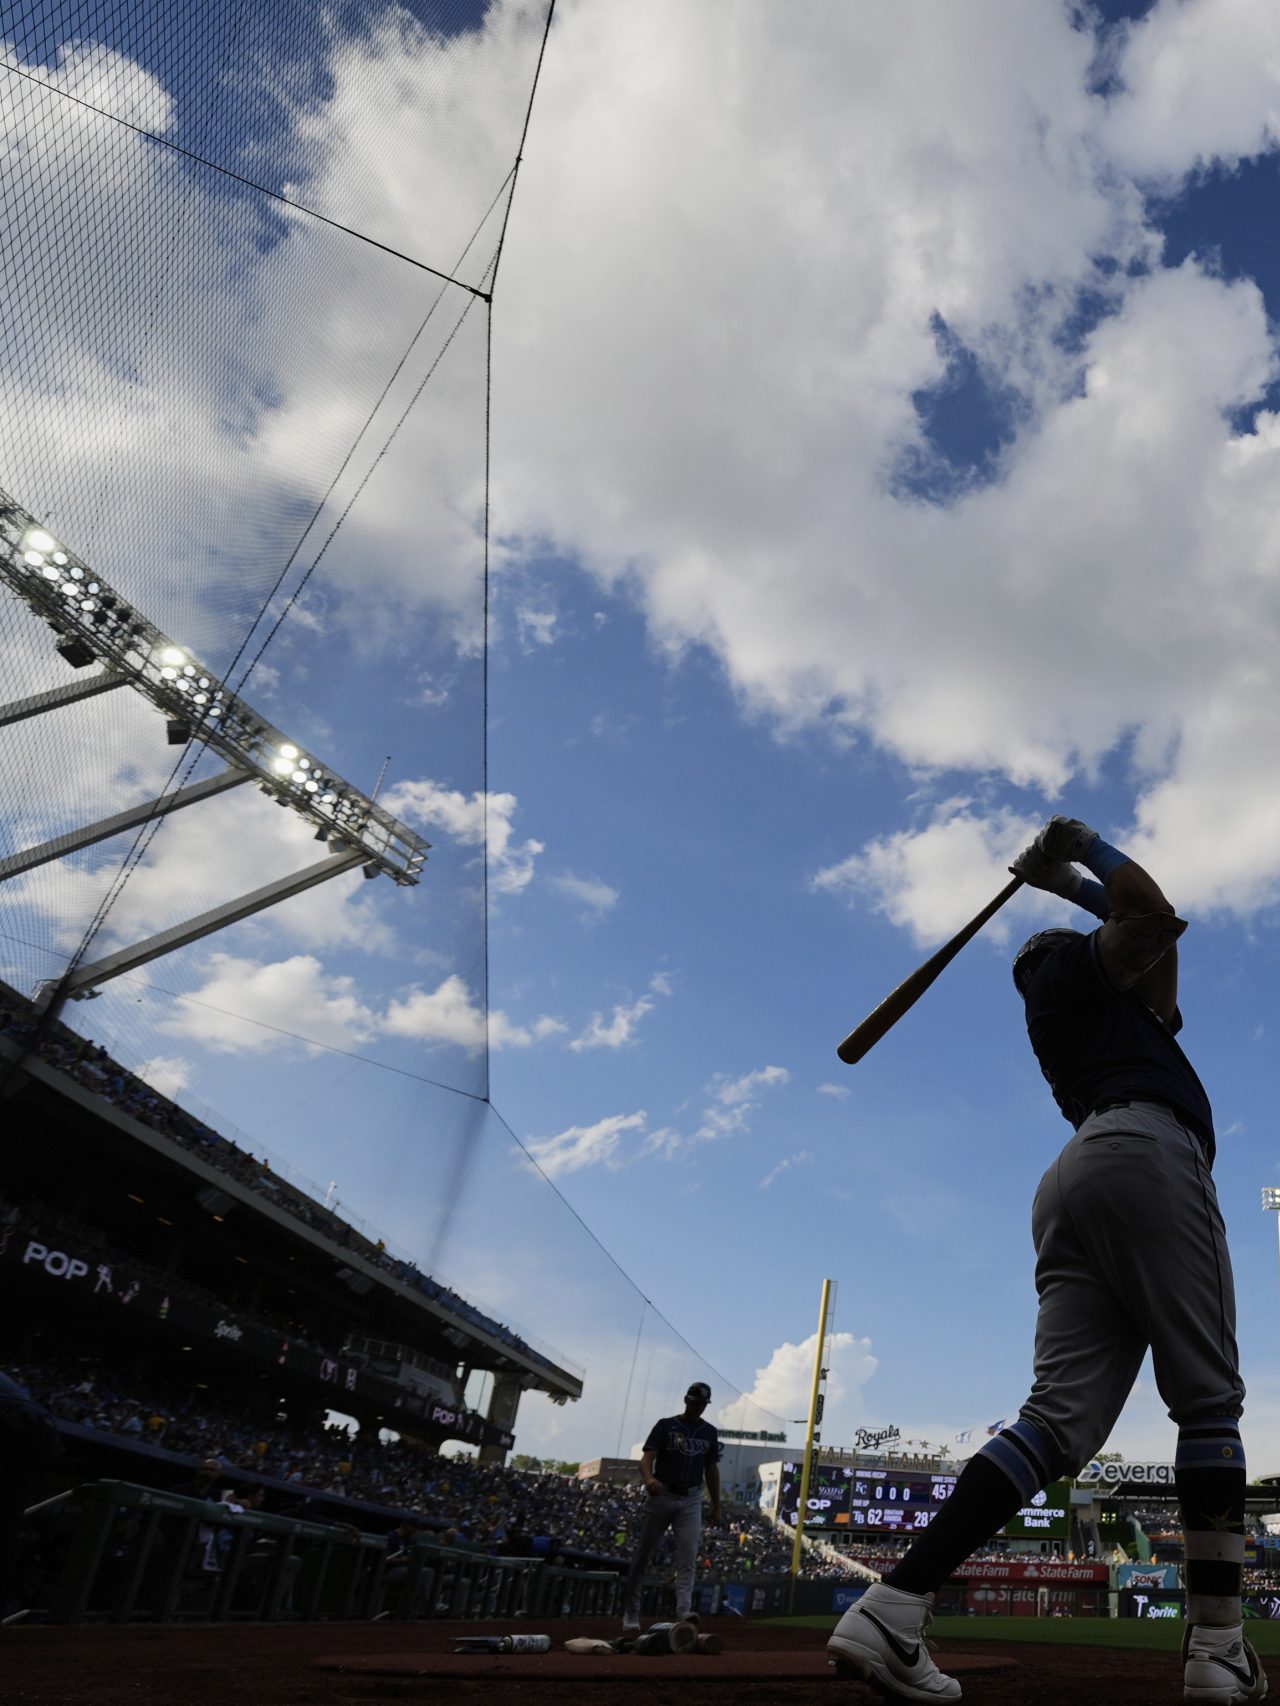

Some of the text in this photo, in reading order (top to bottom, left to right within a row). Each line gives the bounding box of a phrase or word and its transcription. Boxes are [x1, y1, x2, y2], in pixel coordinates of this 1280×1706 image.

[23, 1240, 89, 1280] POP
[432, 1406, 456, 1426] POP
[717, 1430, 787, 1442] mmerce Bank
[855, 1425, 900, 1449] Royals
[876, 1486, 883, 1499] 0
[889, 1487, 896, 1500] 0
[903, 1488, 910, 1501] 0
[932, 1484, 946, 1499] 45
[867, 1509, 882, 1525] 62
[914, 1512, 928, 1527] 28
[1016, 1508, 1065, 1518] ommerce
[1024, 1516, 1051, 1528] Bank
[1134, 1575, 1162, 1585] SONIC
[1147, 1606, 1178, 1619] Sprite
